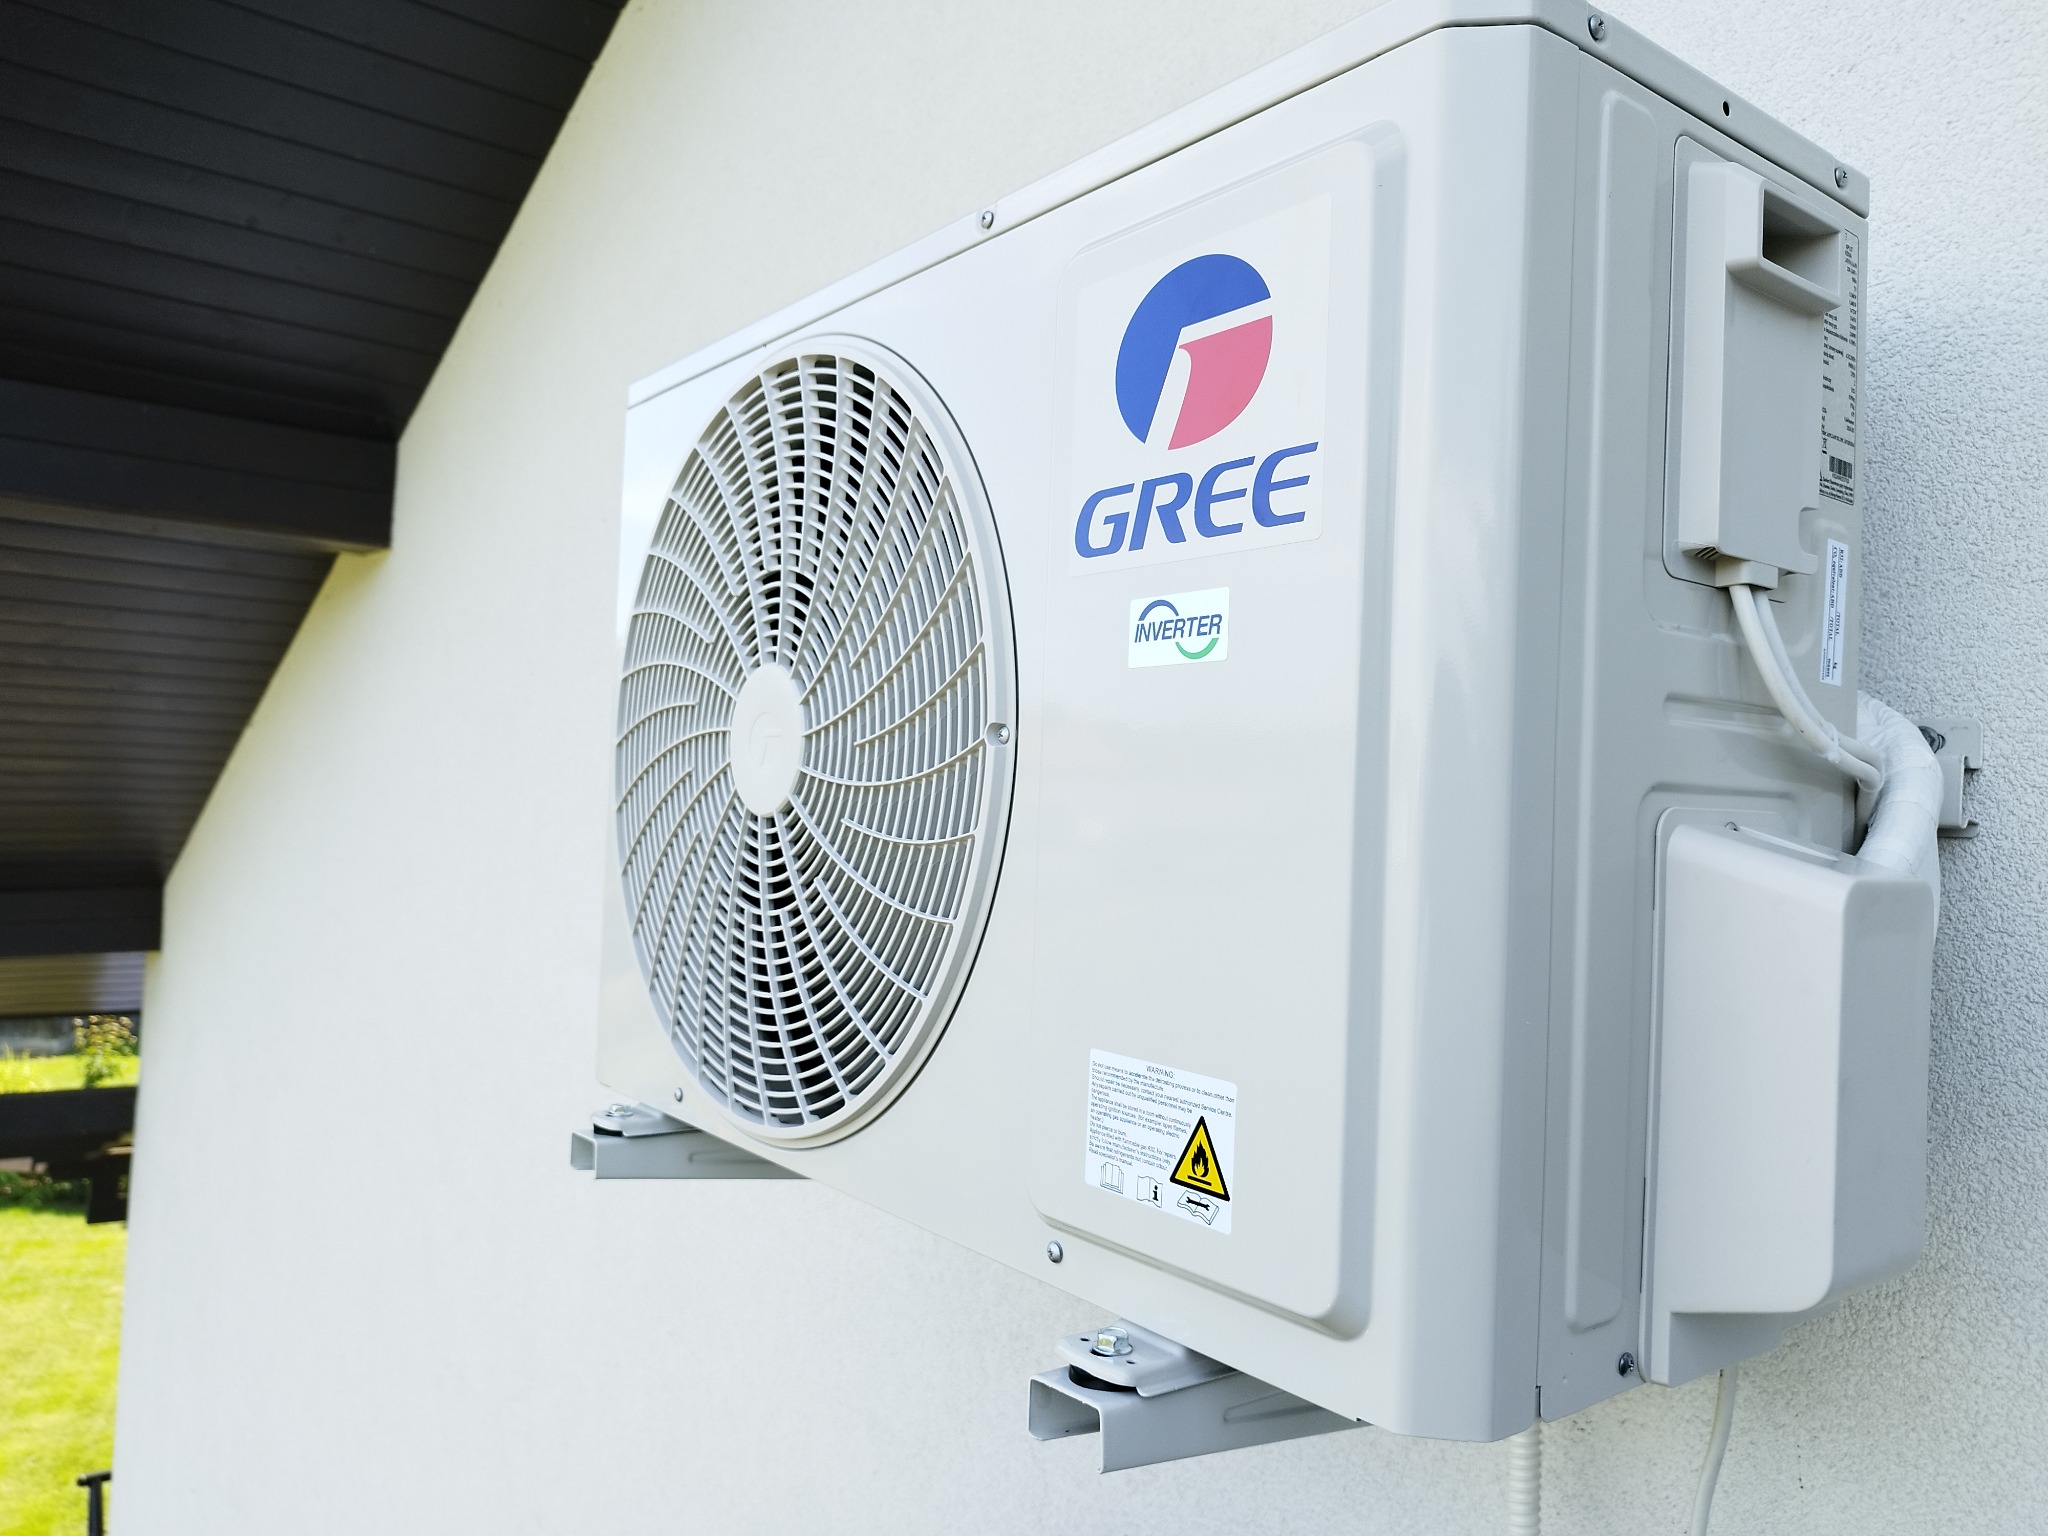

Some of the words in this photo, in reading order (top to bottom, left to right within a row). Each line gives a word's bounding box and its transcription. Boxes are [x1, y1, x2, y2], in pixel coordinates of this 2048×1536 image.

[1075, 442, 1319, 559] GREE
[1134, 614, 1223, 644] INVERTER
[1146, 1065, 1176, 1079] WARNING:
